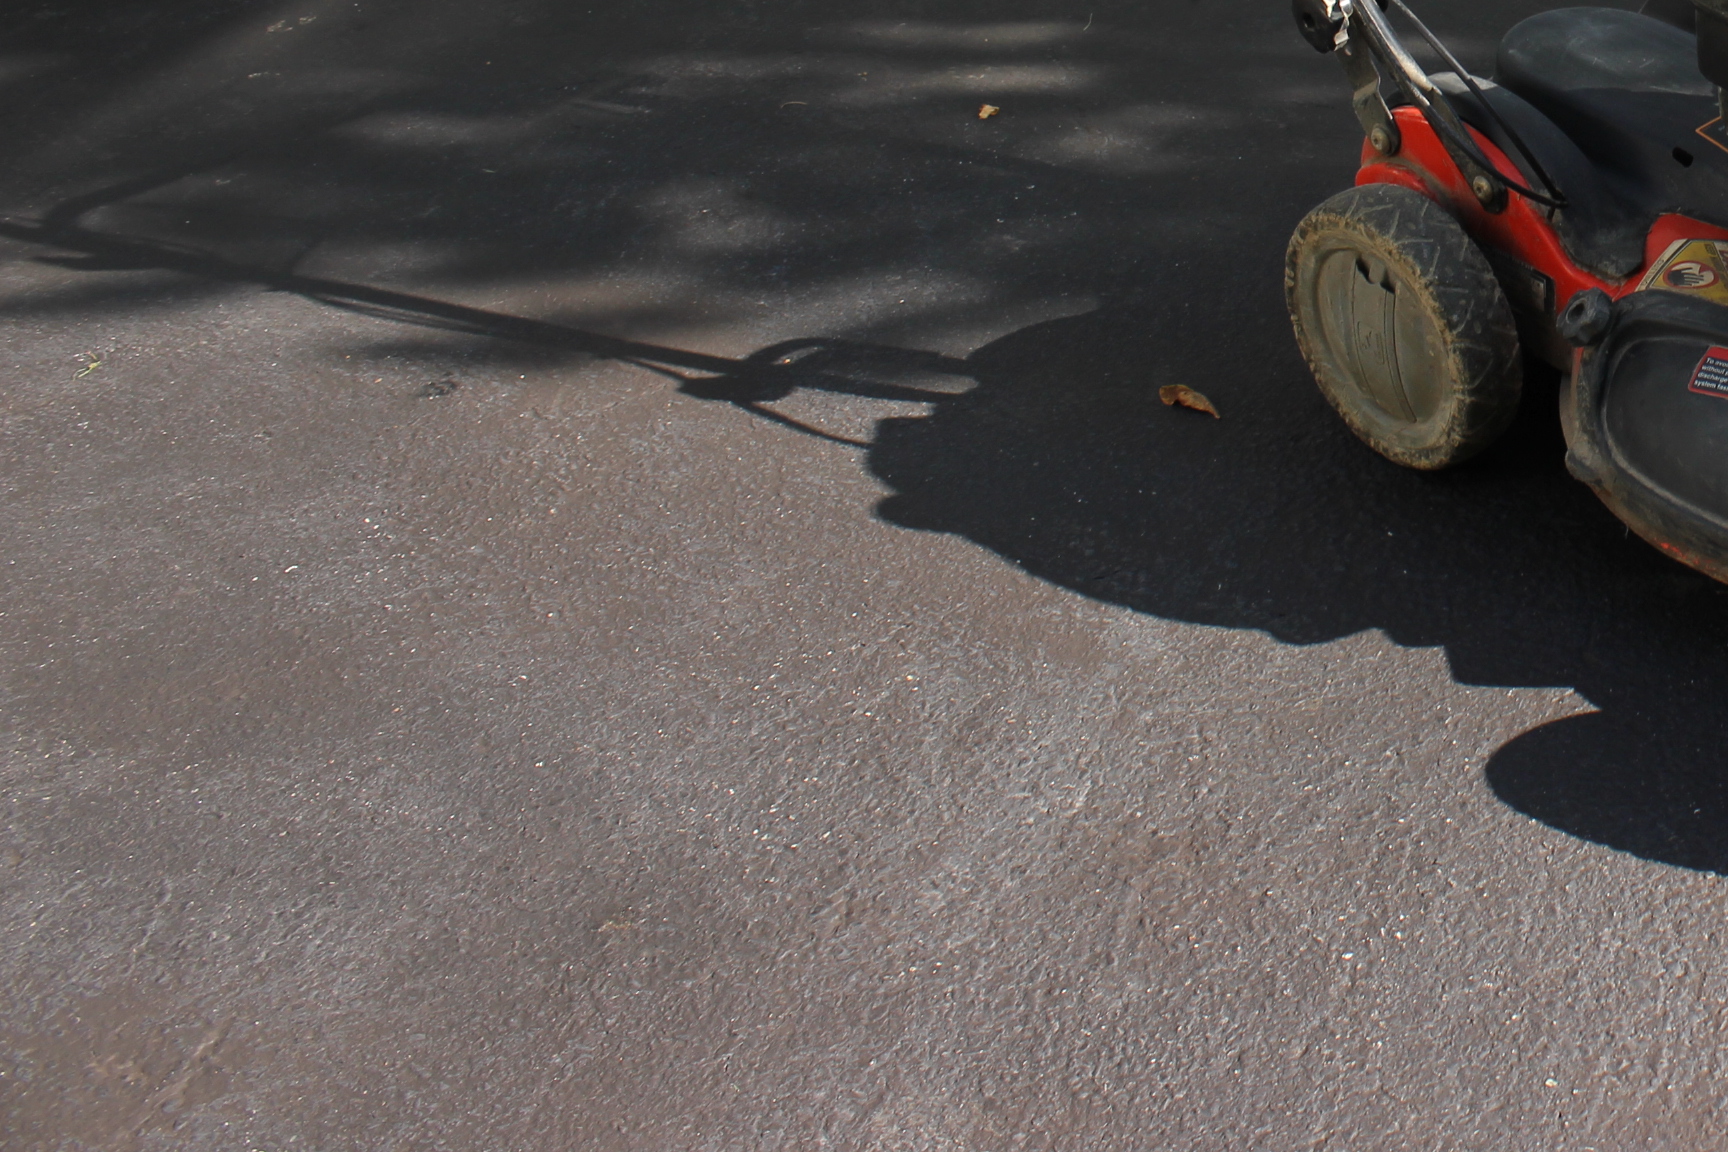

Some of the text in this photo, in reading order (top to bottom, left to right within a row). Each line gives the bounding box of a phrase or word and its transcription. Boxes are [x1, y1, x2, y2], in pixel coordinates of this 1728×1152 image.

[1706, 357, 1715, 365] To
[1702, 364, 1725, 375] without
[1698, 372, 1728, 384] discharge
[1694, 379, 1717, 391] system
